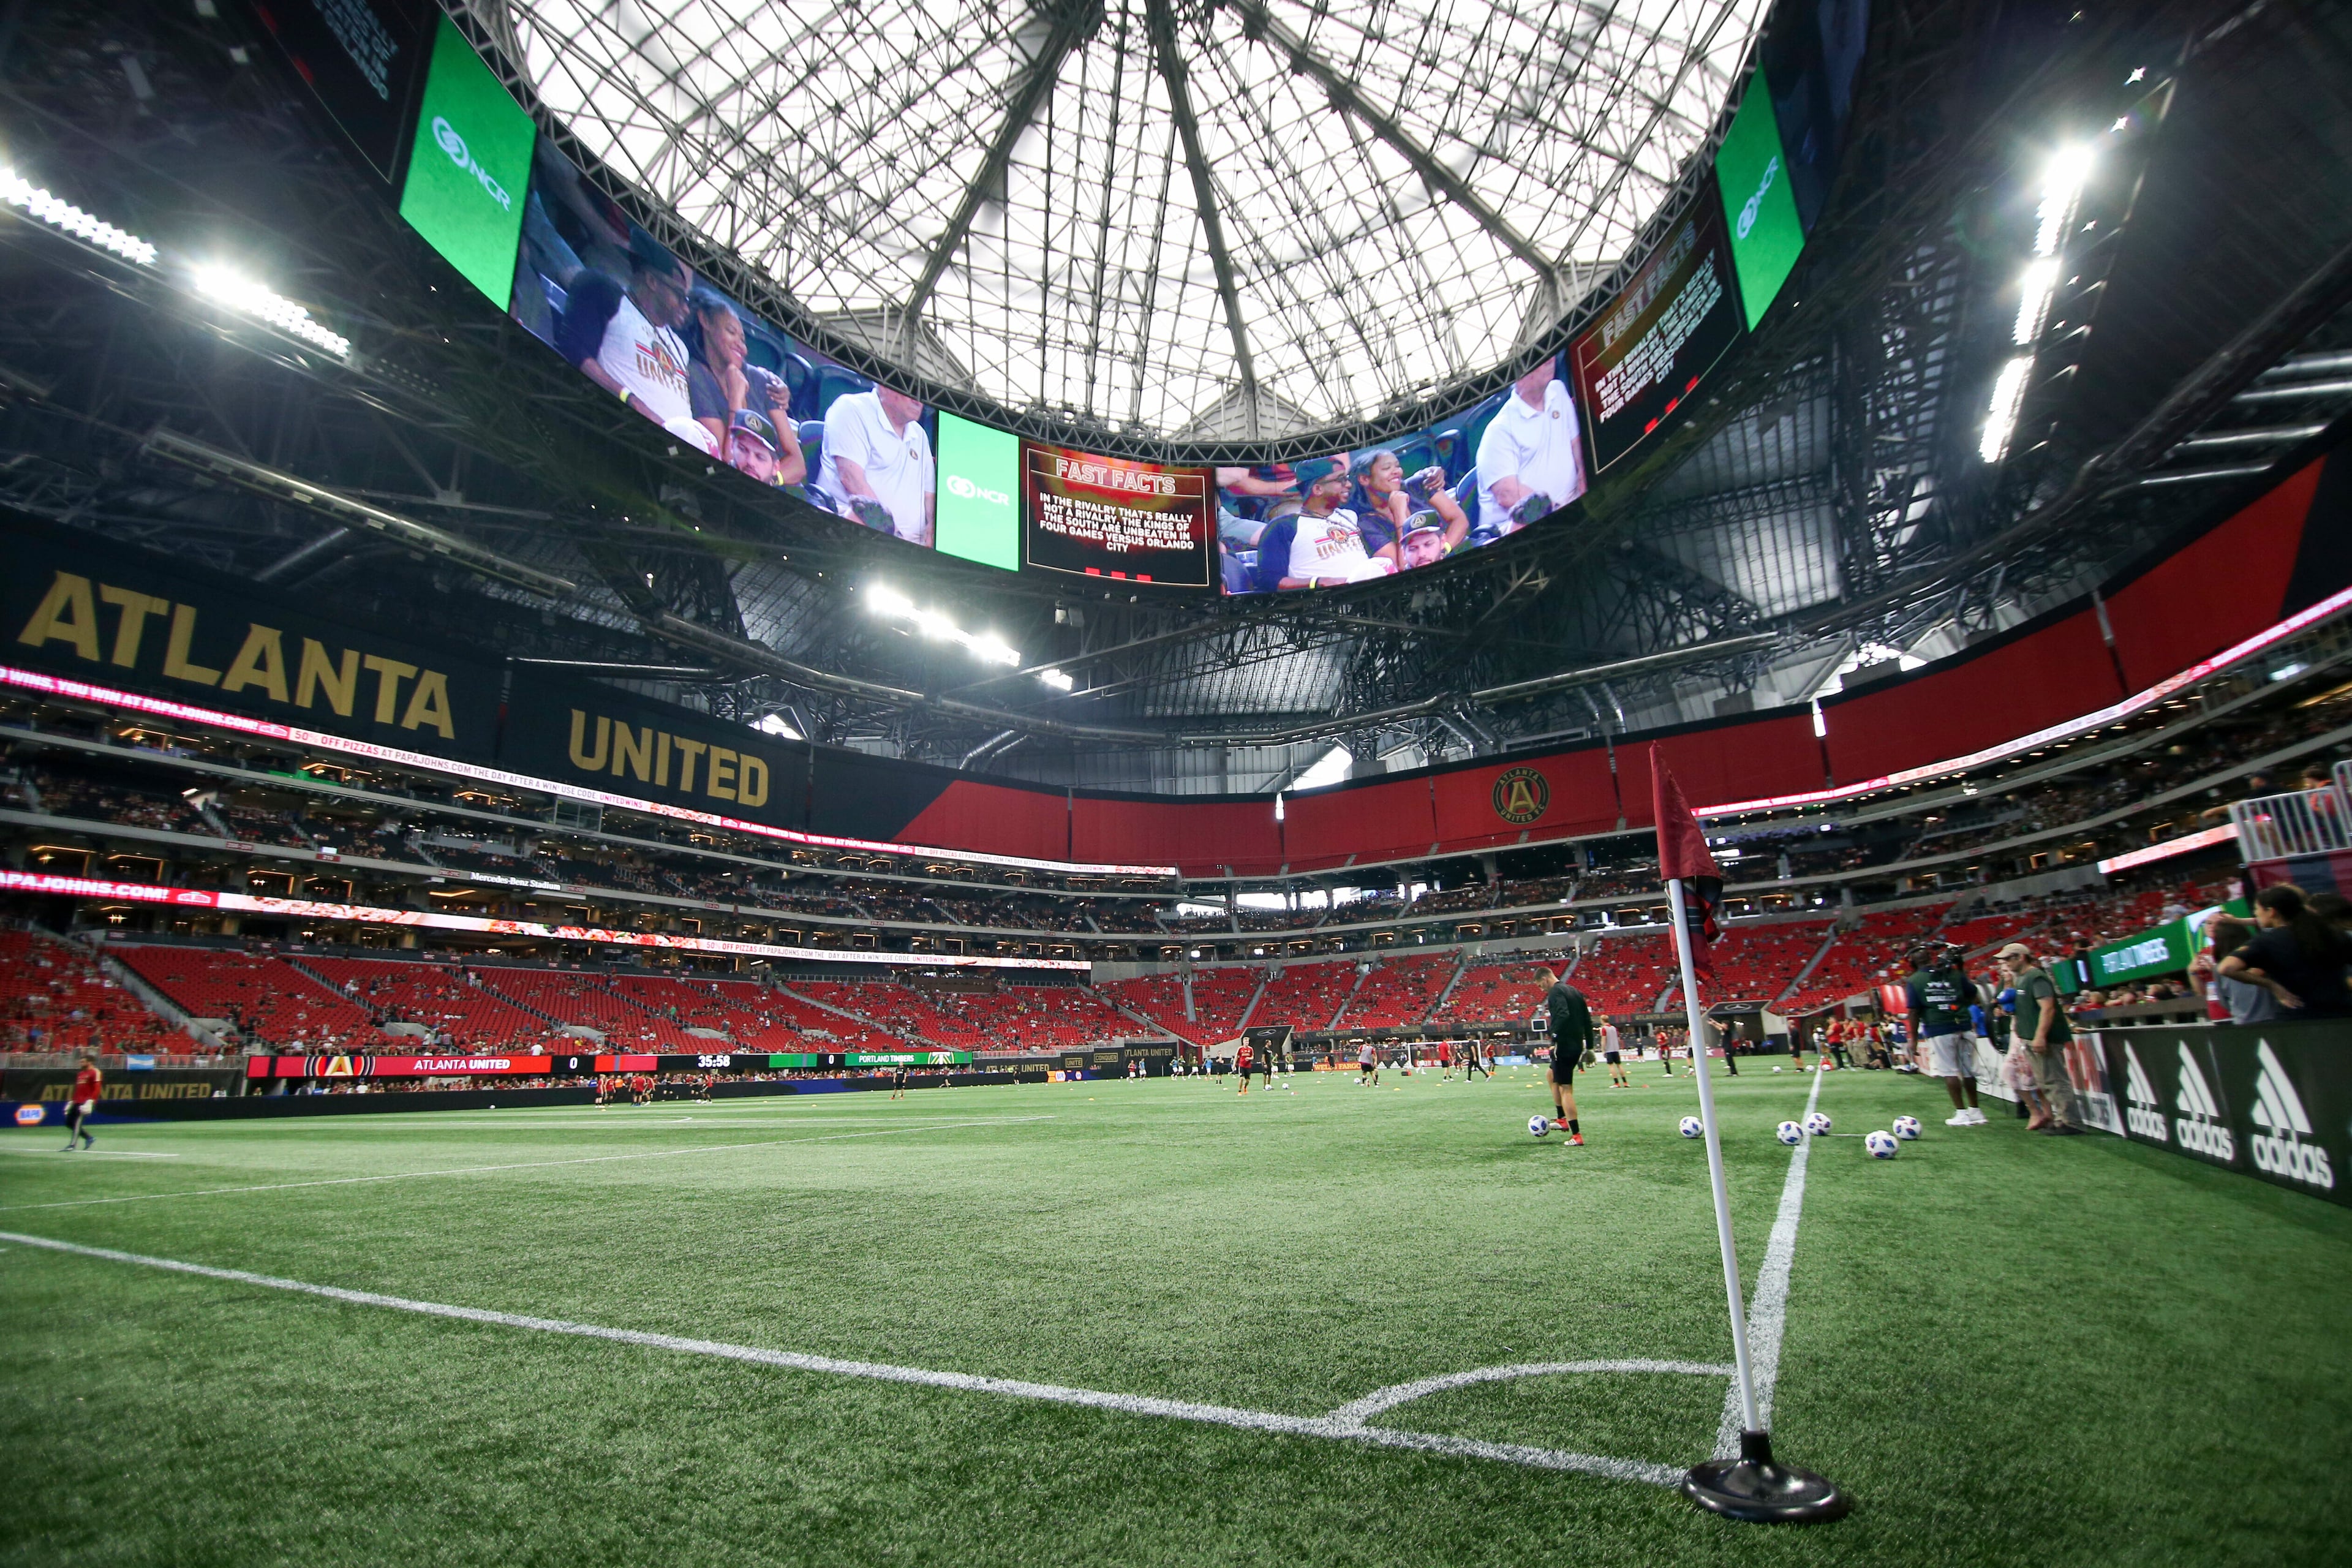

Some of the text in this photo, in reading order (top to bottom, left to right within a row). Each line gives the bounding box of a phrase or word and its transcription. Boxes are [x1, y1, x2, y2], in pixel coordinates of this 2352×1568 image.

[468, 166, 510, 212] NCR
[1602, 298, 1645, 347] FAST
[1600, 377, 1618, 399] NOT
[1600, 397, 1624, 423] FOUR
[1056, 458, 1176, 494] FAST FACTS
[976, 486, 1009, 507] NCR
[1039, 492, 1193, 523] IN THE RIVALRY THAT'S REALLY
[1043, 502, 1064, 514] NOT
[1066, 508, 1073, 516] A
[1121, 517, 1141, 527] THE
[1144, 519, 1174, 531] KINGS
[1176, 522, 1189, 532] OF
[1043, 511, 1190, 541] THE SOUTH ARE UNBEATEN IN
[1039, 520, 1194, 550] FOUR GAMES VERSUS ORLANDO
[1106, 541, 1129, 553] CITY
[17, 570, 454, 739] ATLANTA
[57, 680, 89, 695] YOU
[90, 687, 123, 702] WIN
[123, 695, 143, 707] AT
[143, 698, 258, 731] PAPAJOHNS.COM!
[321, 736, 340, 747] OFF
[343, 741, 379, 755] PIZZAS
[381, 747, 393, 757] AT
[394, 751, 472, 774] PAPAJOHNS.COM
[473, 767, 489, 777] THE
[491, 771, 507, 782] DAY
[509, 775, 533, 786] AFTER
[561, 785, 575, 795] USE
[600, 793, 643, 809] UNITEDWINS
[569, 709, 768, 807] UNITED
[1499, 769, 1539, 785] ATLANTA
[1509, 781, 1536, 812] A
[1501, 804, 1545, 821] UNITED FC
[470, 872, 529, 888] Mercedes-Benz
[529, 880, 561, 891] Stadium
[767, 948, 813, 957] PAPAJOHNS.COM
[413, 1060, 467, 1070] ATLANTA
[469, 1059, 511, 1070] UNITED
[569, 1057, 577, 1069] 0
[698, 1055, 730, 1068] 35:58
[827, 1055, 834, 1065] 0
[890, 1054, 914, 1063] TIMBERS
[40, 1083, 212, 1101] ATNTA UNITED
[2127, 1103, 2167, 1141] adidas
[2176, 1110, 2233, 1161] adidas
[2252, 1126, 2334, 1188] adidas
